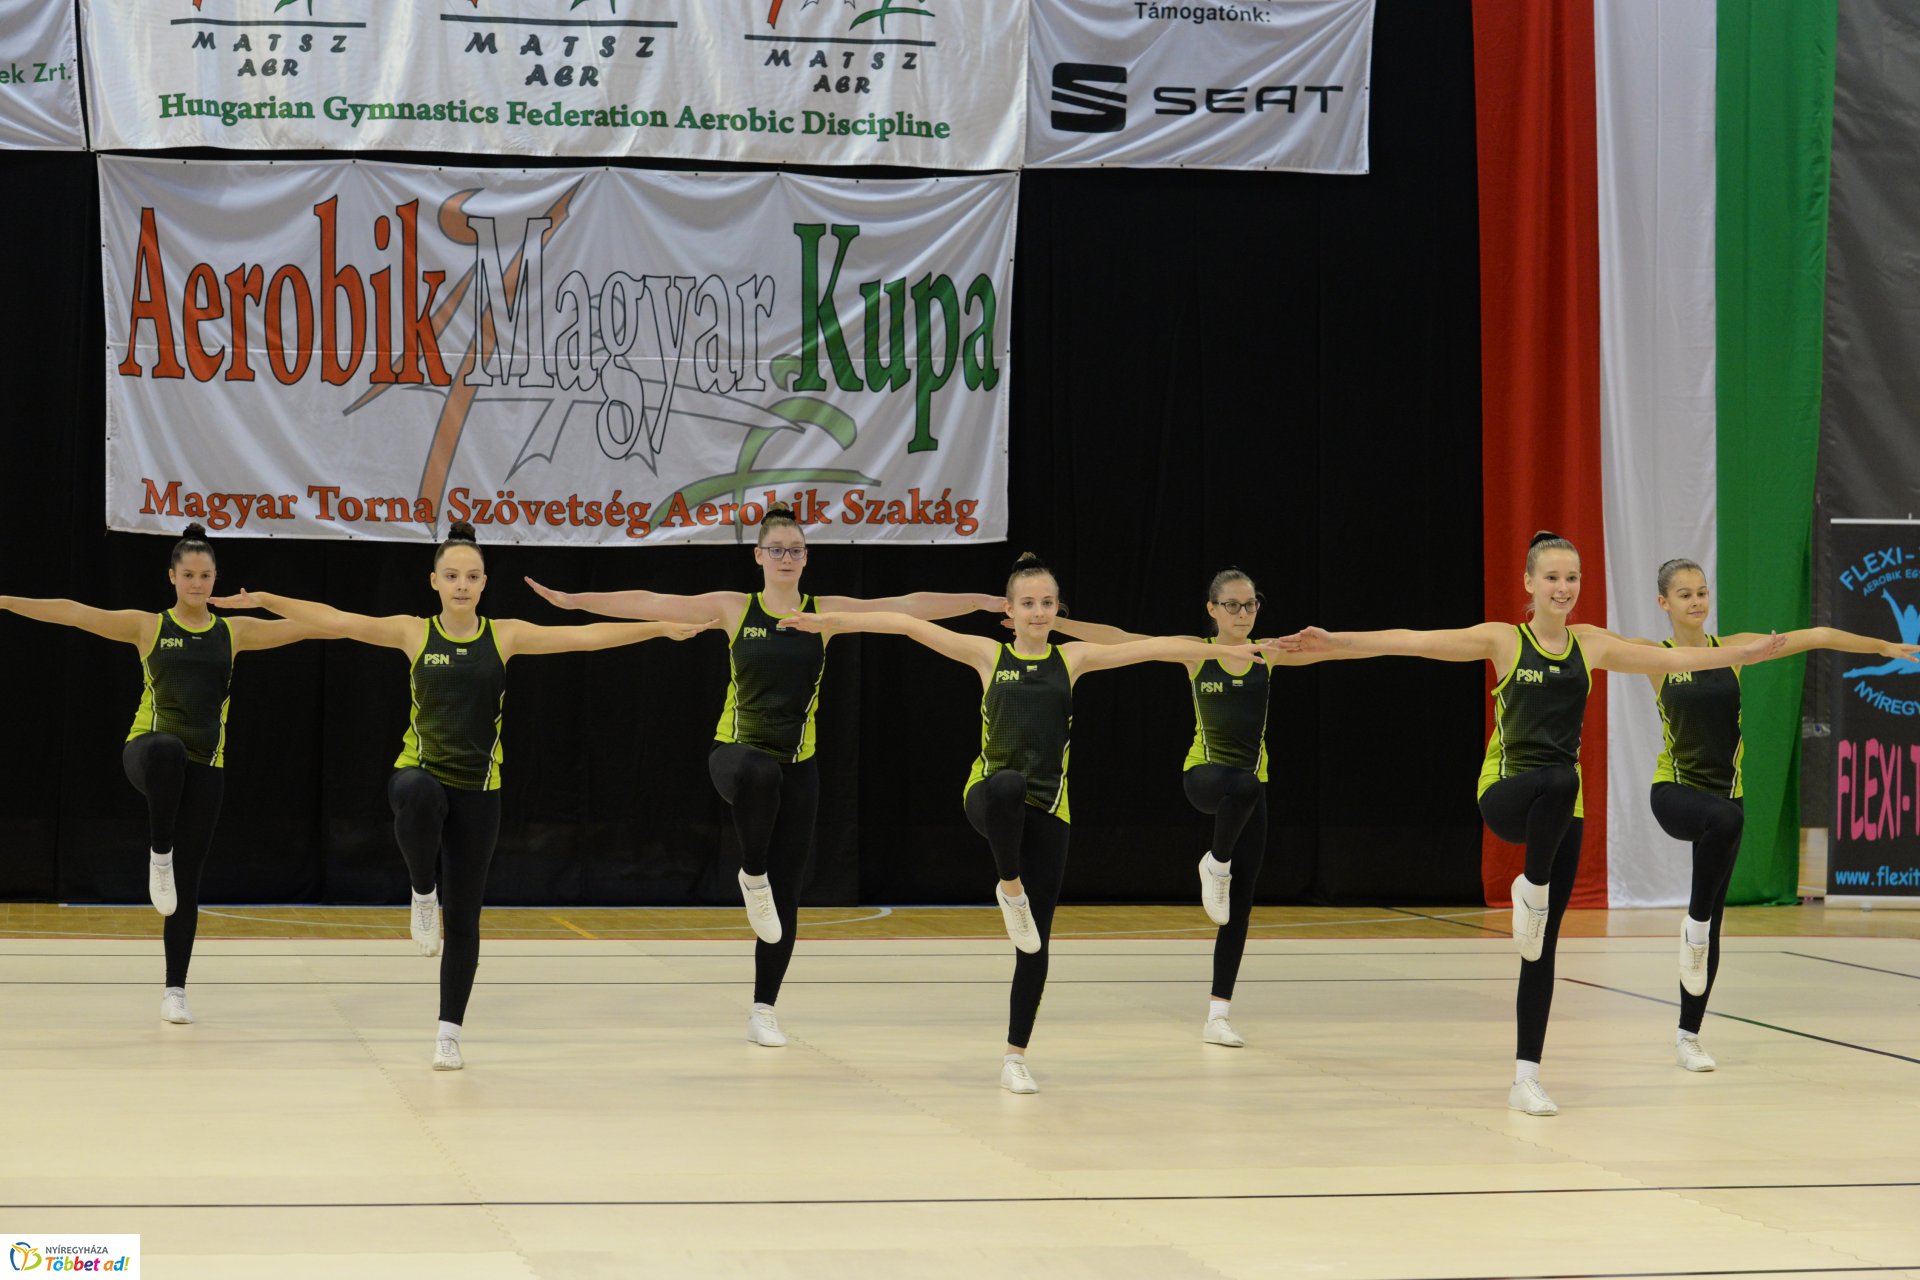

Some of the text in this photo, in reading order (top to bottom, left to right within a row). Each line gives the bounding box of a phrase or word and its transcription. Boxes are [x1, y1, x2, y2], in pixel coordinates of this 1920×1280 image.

[1134, 2, 1272, 25] Támogatónk:
[0, 62, 72, 84] ek Zrt.
[1153, 85, 1344, 116] SEAT
[159, 93, 951, 142] Hungarian Gymnastics Federation Aerobic Discipline
[118, 195, 1000, 460] Aerobik Magyar Kupa
[139, 478, 298, 530] Magyar
[306, 484, 436, 524] Torna
[446, 487, 652, 539] Szövetség
[841, 487, 980, 537] Szakág
[1863, 569, 1902, 597] AEROBIK
[743, 626, 767, 638] PSN
[160, 637, 184, 649] PSN
[424, 653, 450, 665] PSN
[996, 669, 1020, 683] PSN
[1516, 668, 1544, 684] PSN
[1668, 671, 1693, 684] PSN
[1200, 681, 1224, 693] PSN
